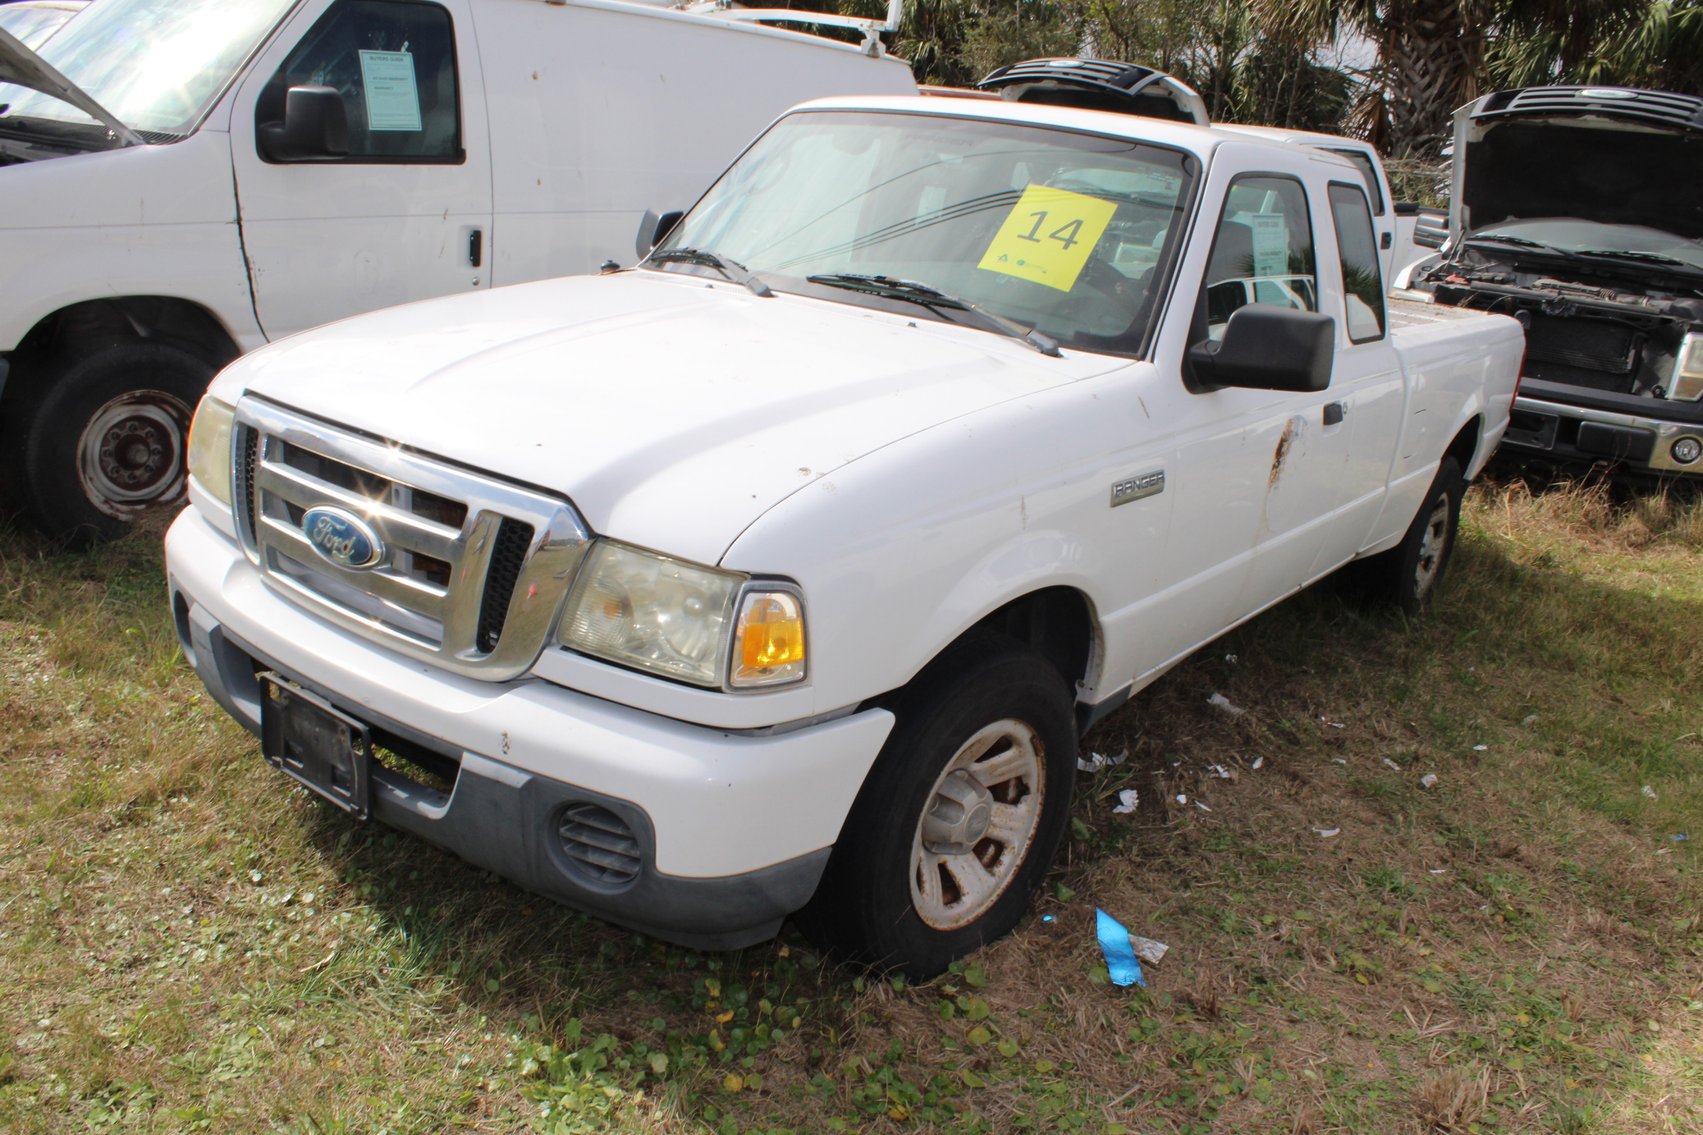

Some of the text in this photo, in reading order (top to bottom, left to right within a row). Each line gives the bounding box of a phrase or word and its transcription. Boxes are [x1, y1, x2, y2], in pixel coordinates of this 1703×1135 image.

[1017, 210, 1084, 251] 14
[1112, 472, 1164, 498] RANGER
[313, 516, 356, 559] Ford
